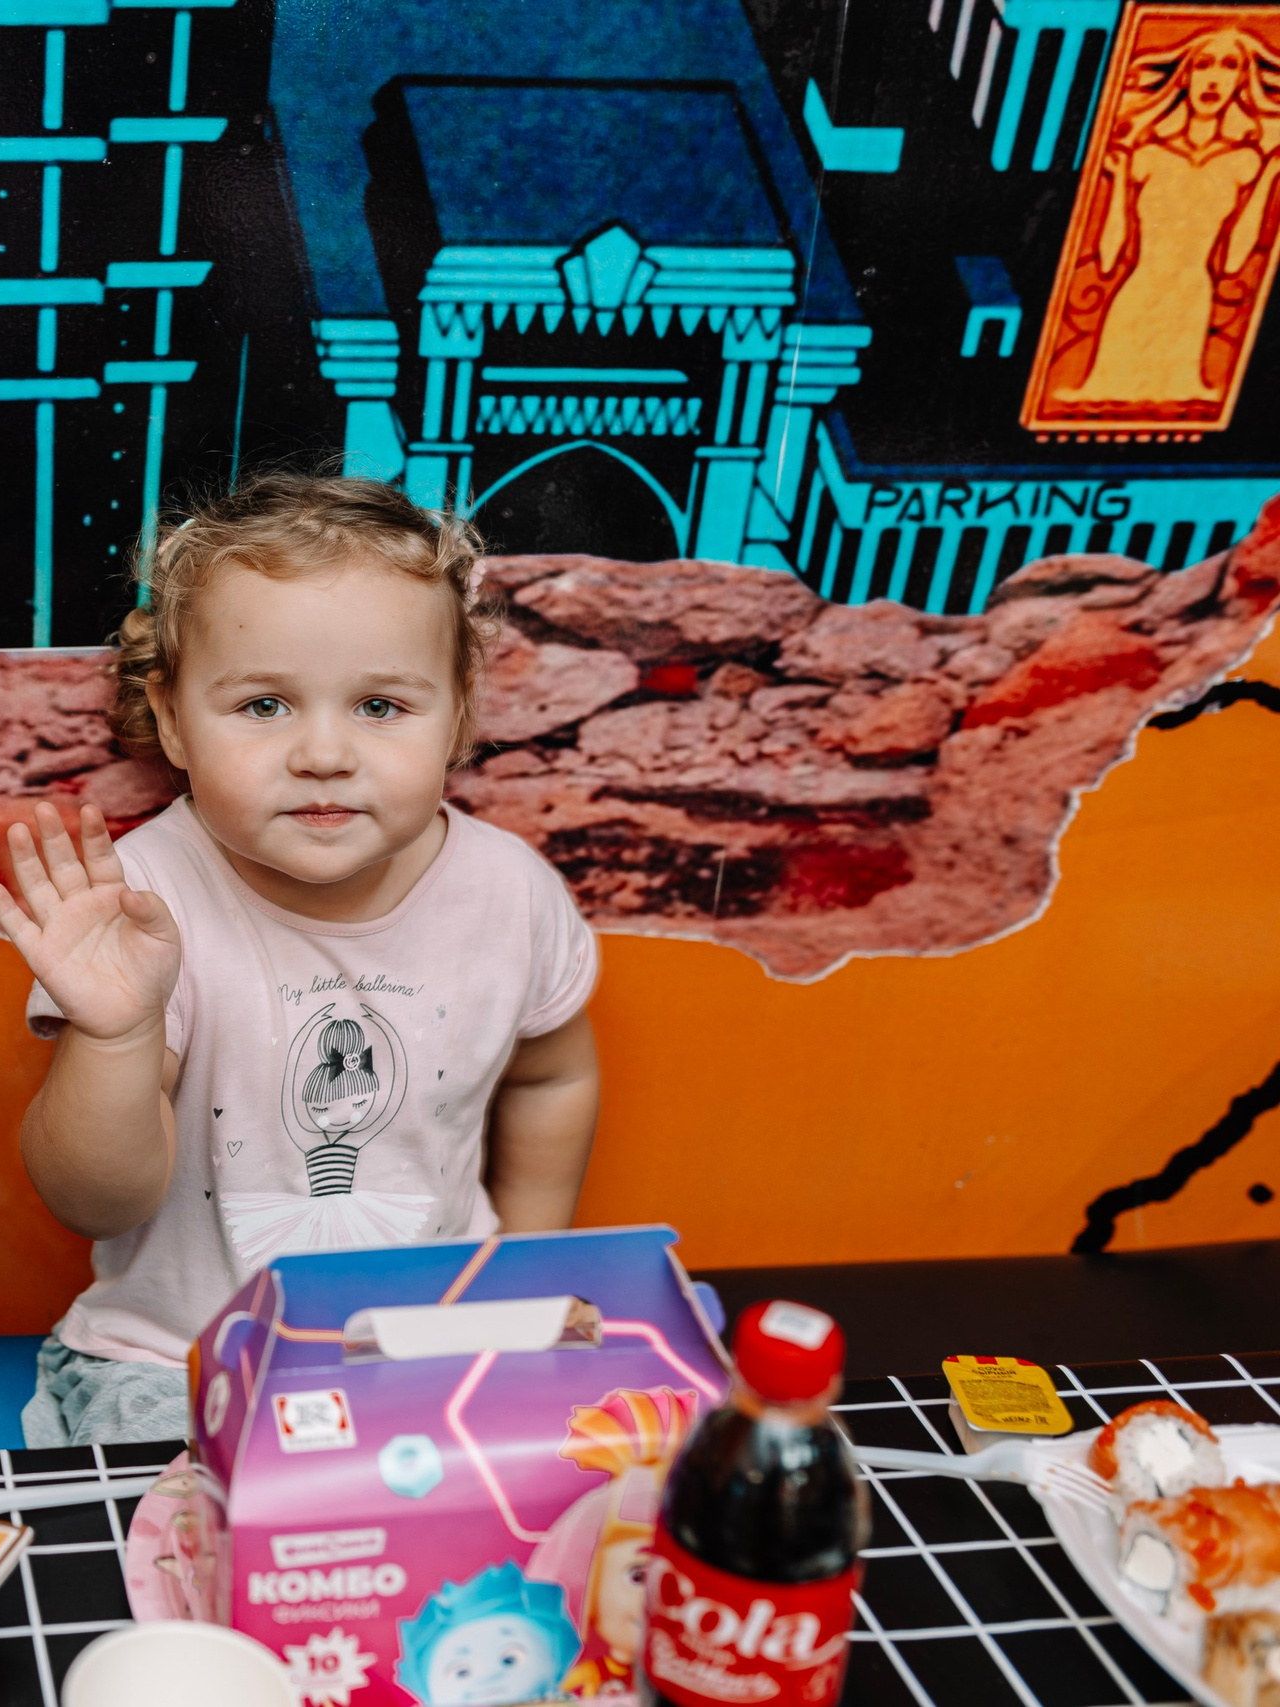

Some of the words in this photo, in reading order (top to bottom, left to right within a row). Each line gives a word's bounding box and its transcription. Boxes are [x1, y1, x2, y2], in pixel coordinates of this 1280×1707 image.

[863, 480, 1131, 522] PARKING
[308, 973, 347, 994] little
[352, 974, 425, 998] ballerina!
[248, 1562, 407, 1605] КОМБО
[644, 1554, 847, 1669] Cola
[307, 1653, 339, 1674] 10
